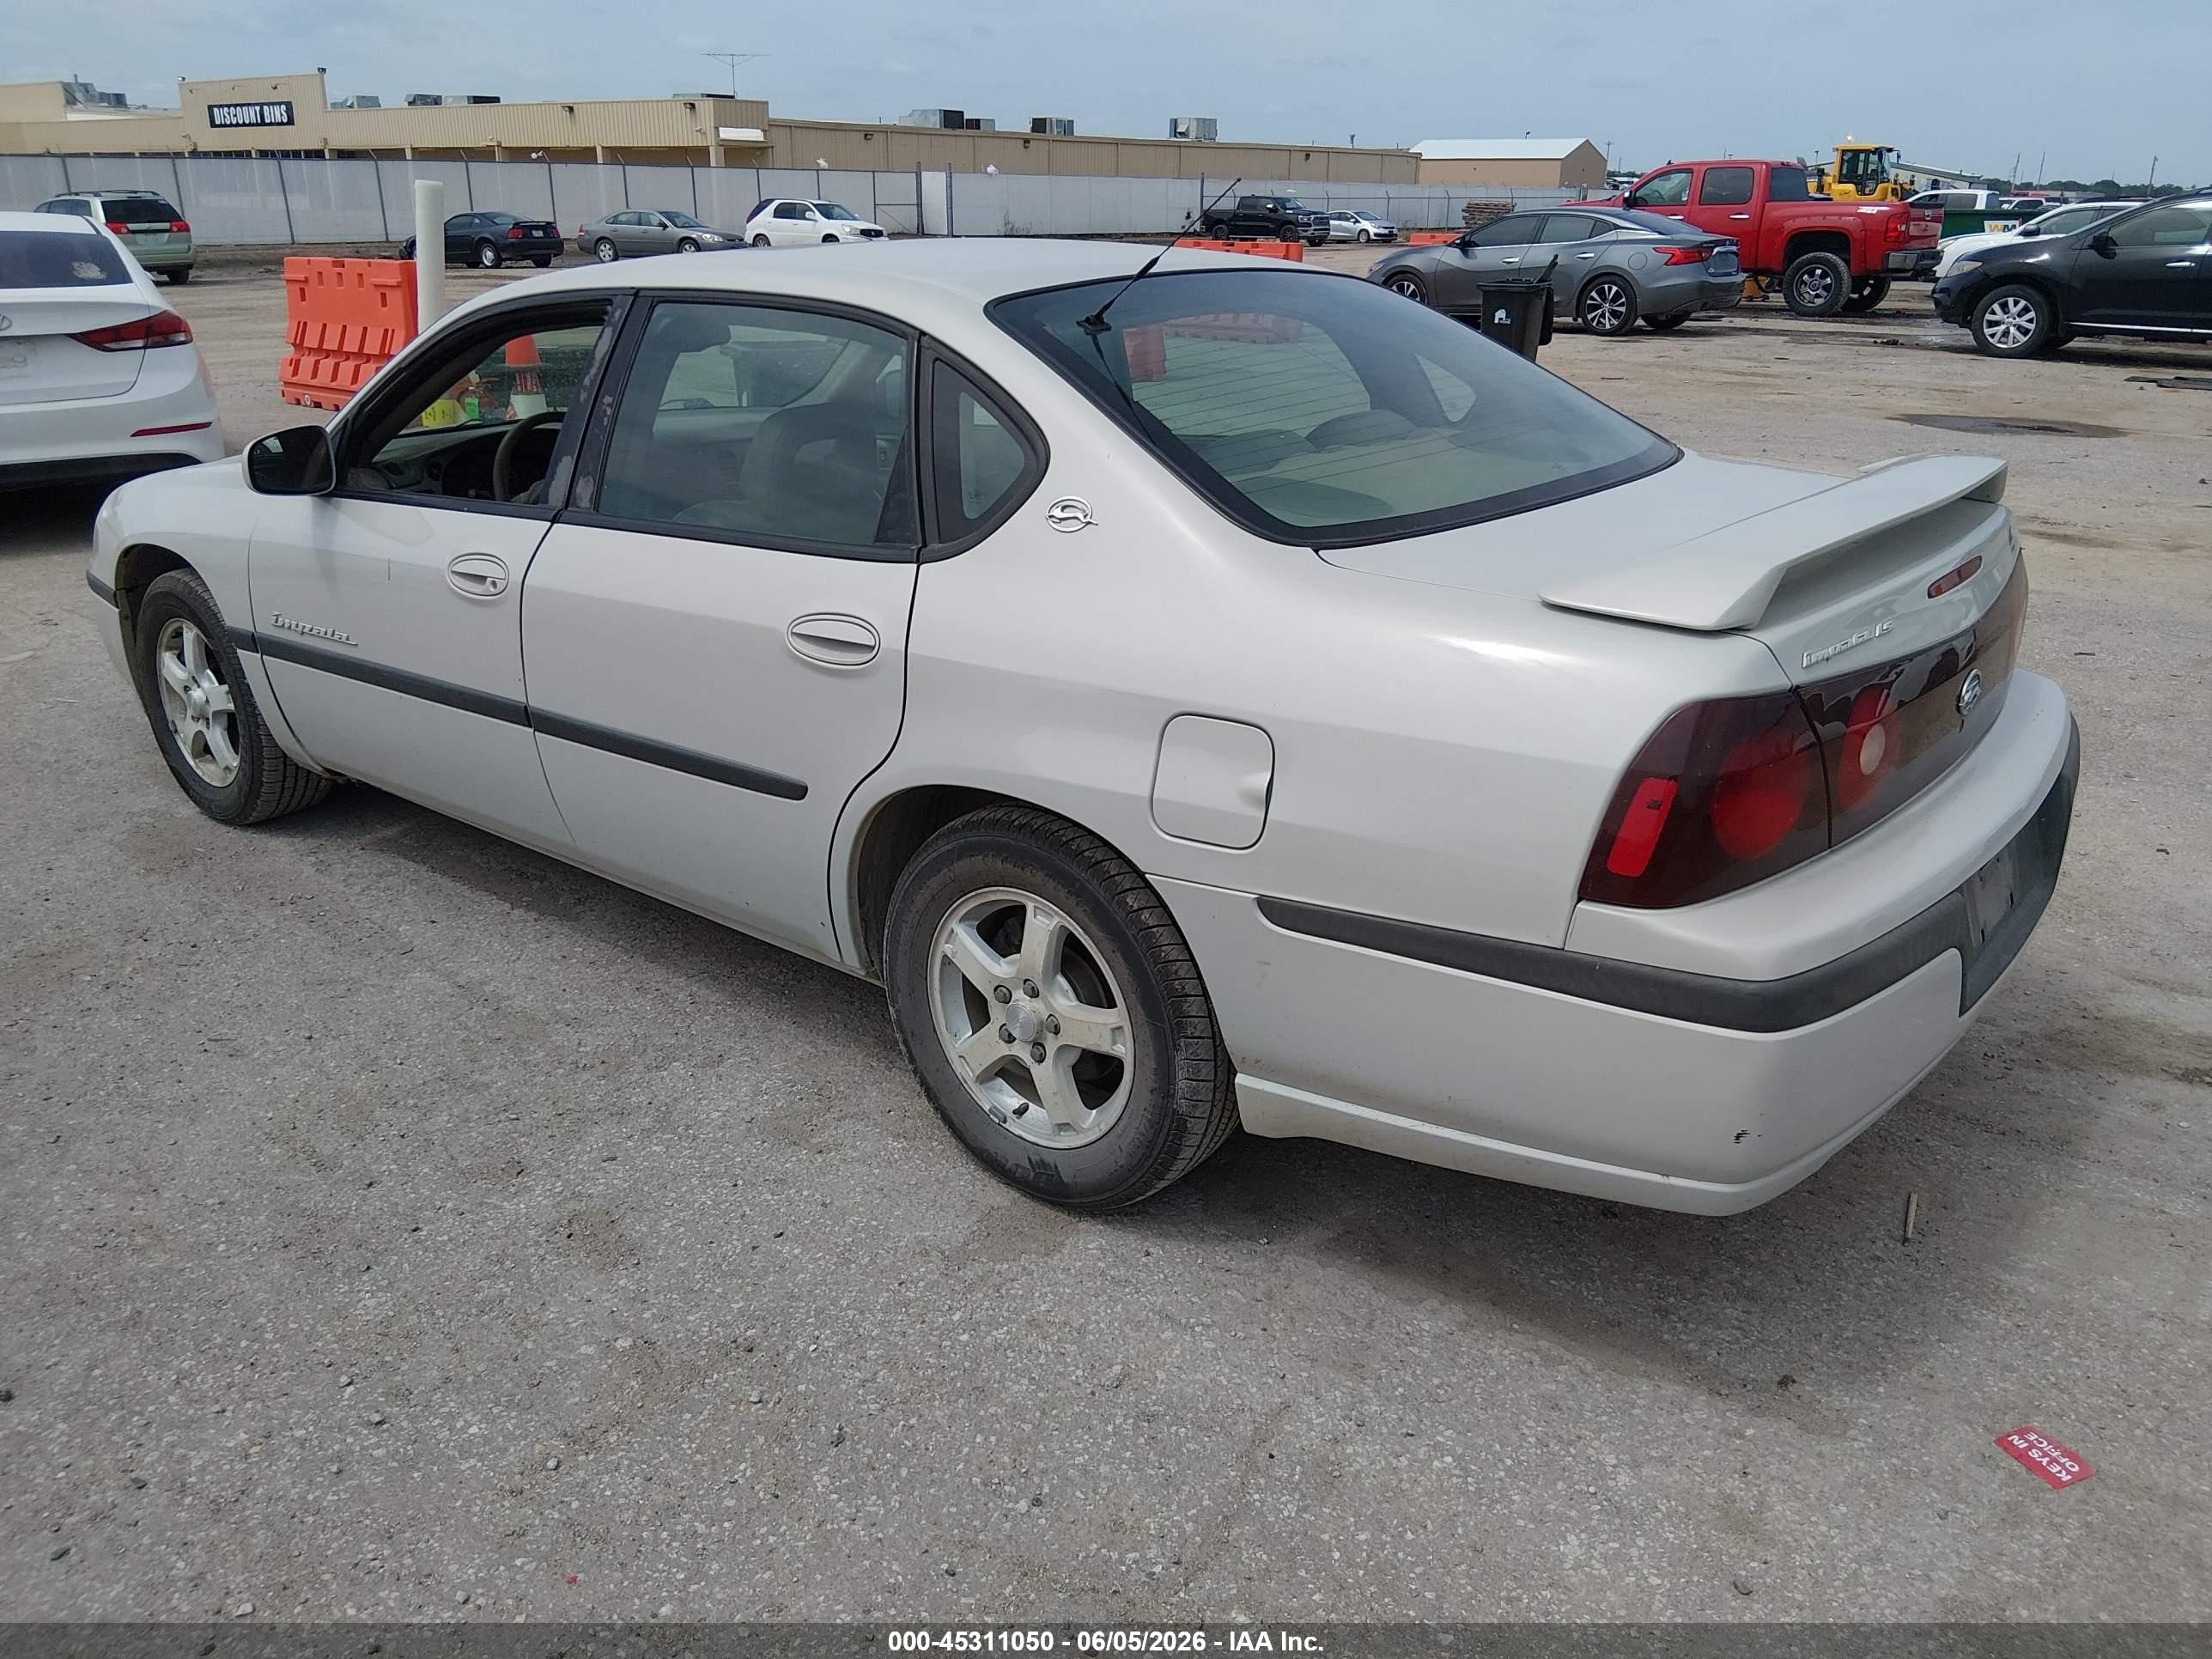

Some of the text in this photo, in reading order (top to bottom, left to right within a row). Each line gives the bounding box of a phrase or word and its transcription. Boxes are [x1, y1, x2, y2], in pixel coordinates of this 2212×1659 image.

[213, 104, 288, 125] DISCOUNT BINS
[270, 611, 359, 646] Impala
[2007, 1434, 2073, 1482] KEYS IN
[2024, 1431, 2080, 1473] OFFICE
